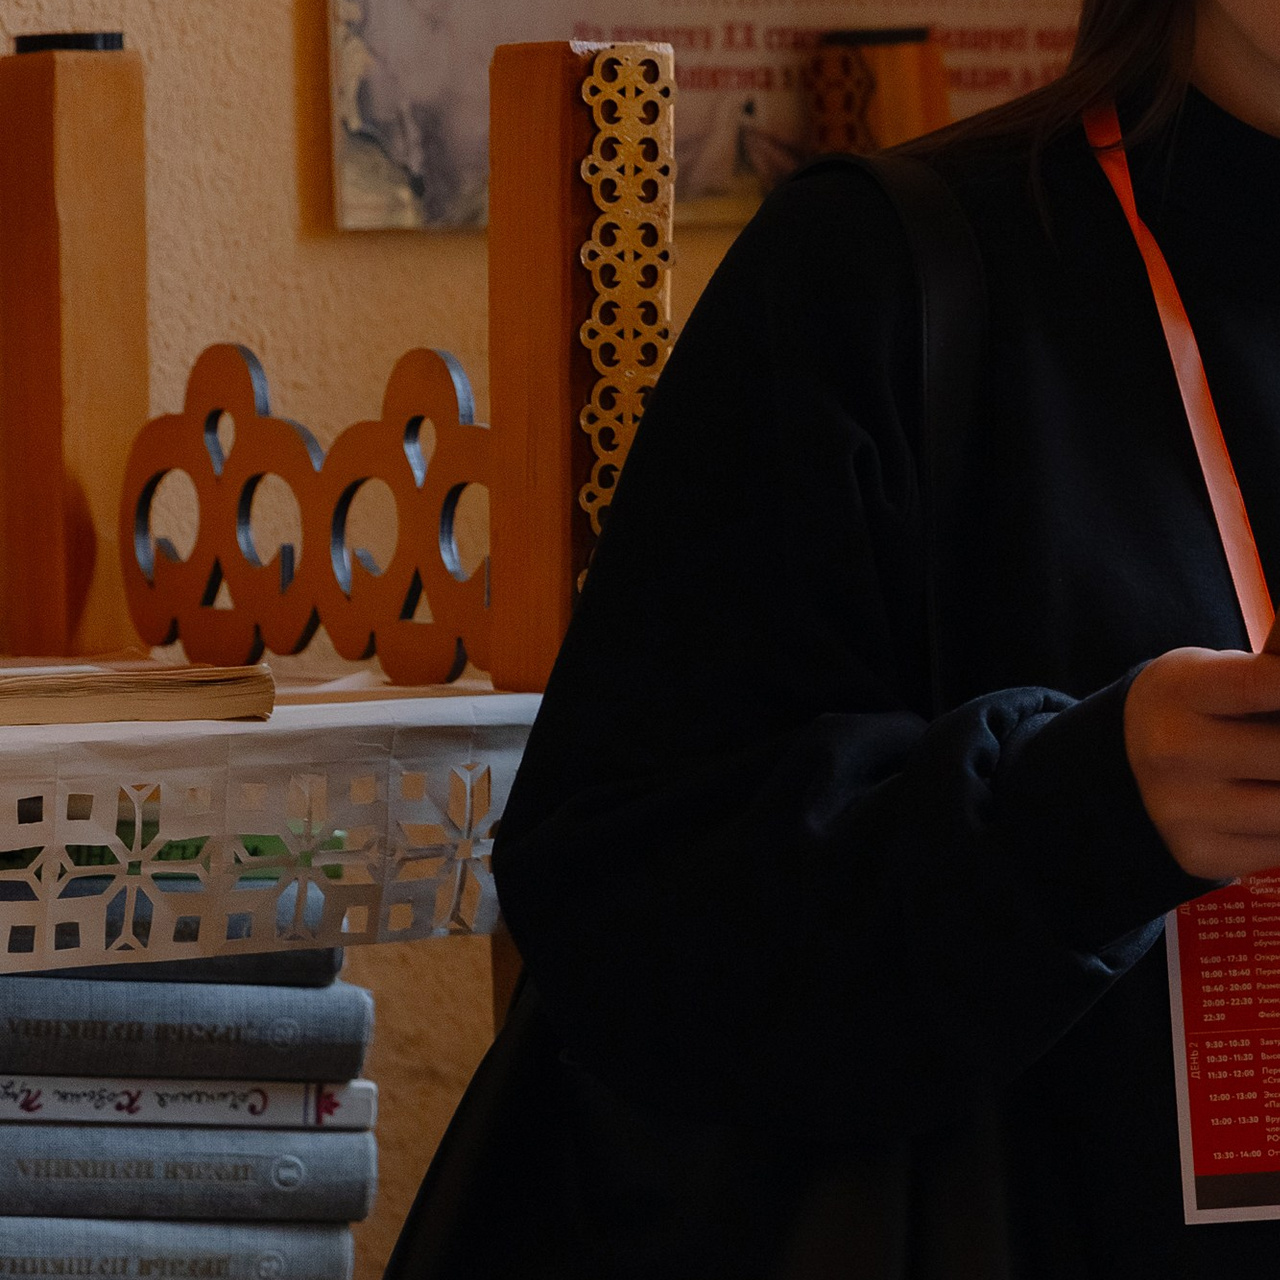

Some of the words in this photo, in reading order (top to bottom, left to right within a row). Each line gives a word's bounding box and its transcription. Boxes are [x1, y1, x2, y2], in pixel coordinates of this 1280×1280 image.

[1189, 1050, 1201, 1080] ДЕНЬ
[16, 1159, 155, 1180] ПУШКИНА
[163, 1162, 253, 1183] ДРУЗЬЯ
[138, 1257, 230, 1278] ДРУЗЬЯ
